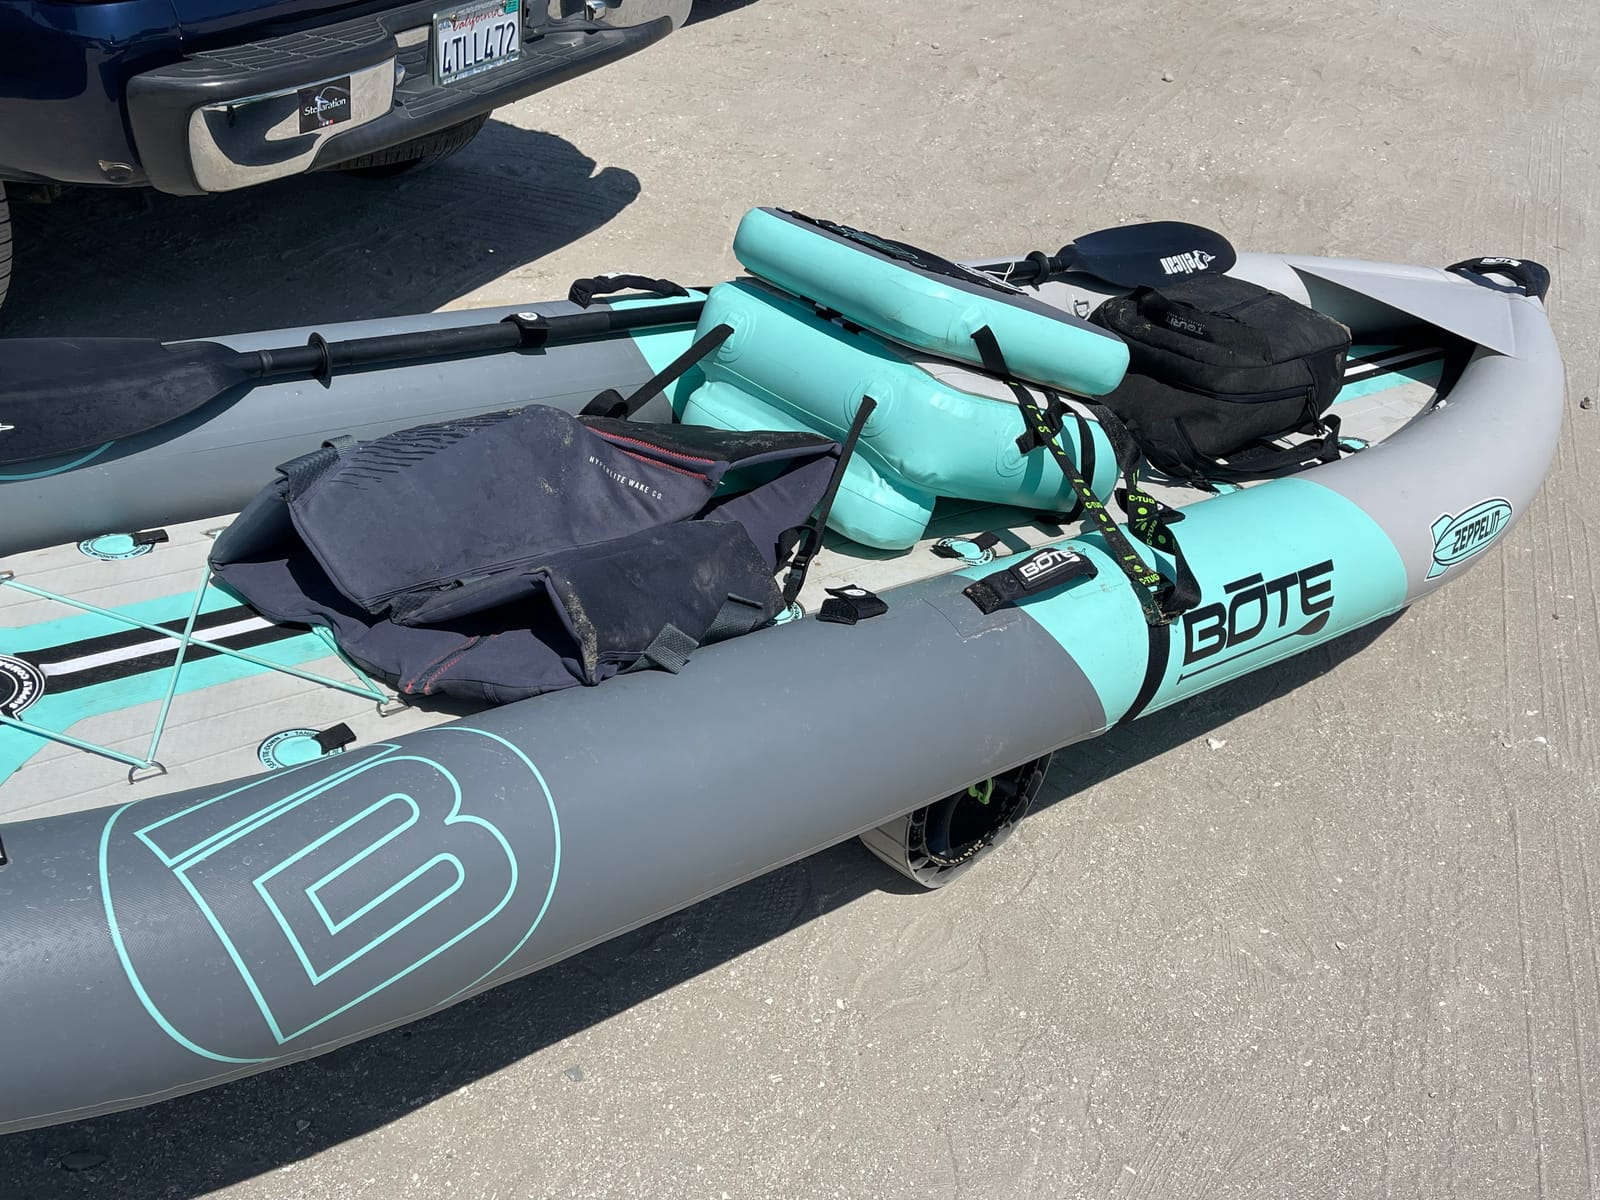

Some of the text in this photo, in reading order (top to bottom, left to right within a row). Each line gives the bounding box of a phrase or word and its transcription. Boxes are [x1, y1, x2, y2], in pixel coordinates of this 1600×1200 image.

[451, 8, 504, 31] California
[442, 21, 516, 74] 4TLL472
[1160, 250, 1209, 275] Pelican
[589, 456, 626, 484] HYPERLITE
[628, 478, 650, 494] WAKE
[1128, 494, 1155, 504] C-TUG
[1146, 519, 1158, 546] C-TUG
[1451, 510, 1500, 555] ZEPPELIN
[1139, 573, 1160, 585] C-TUG
